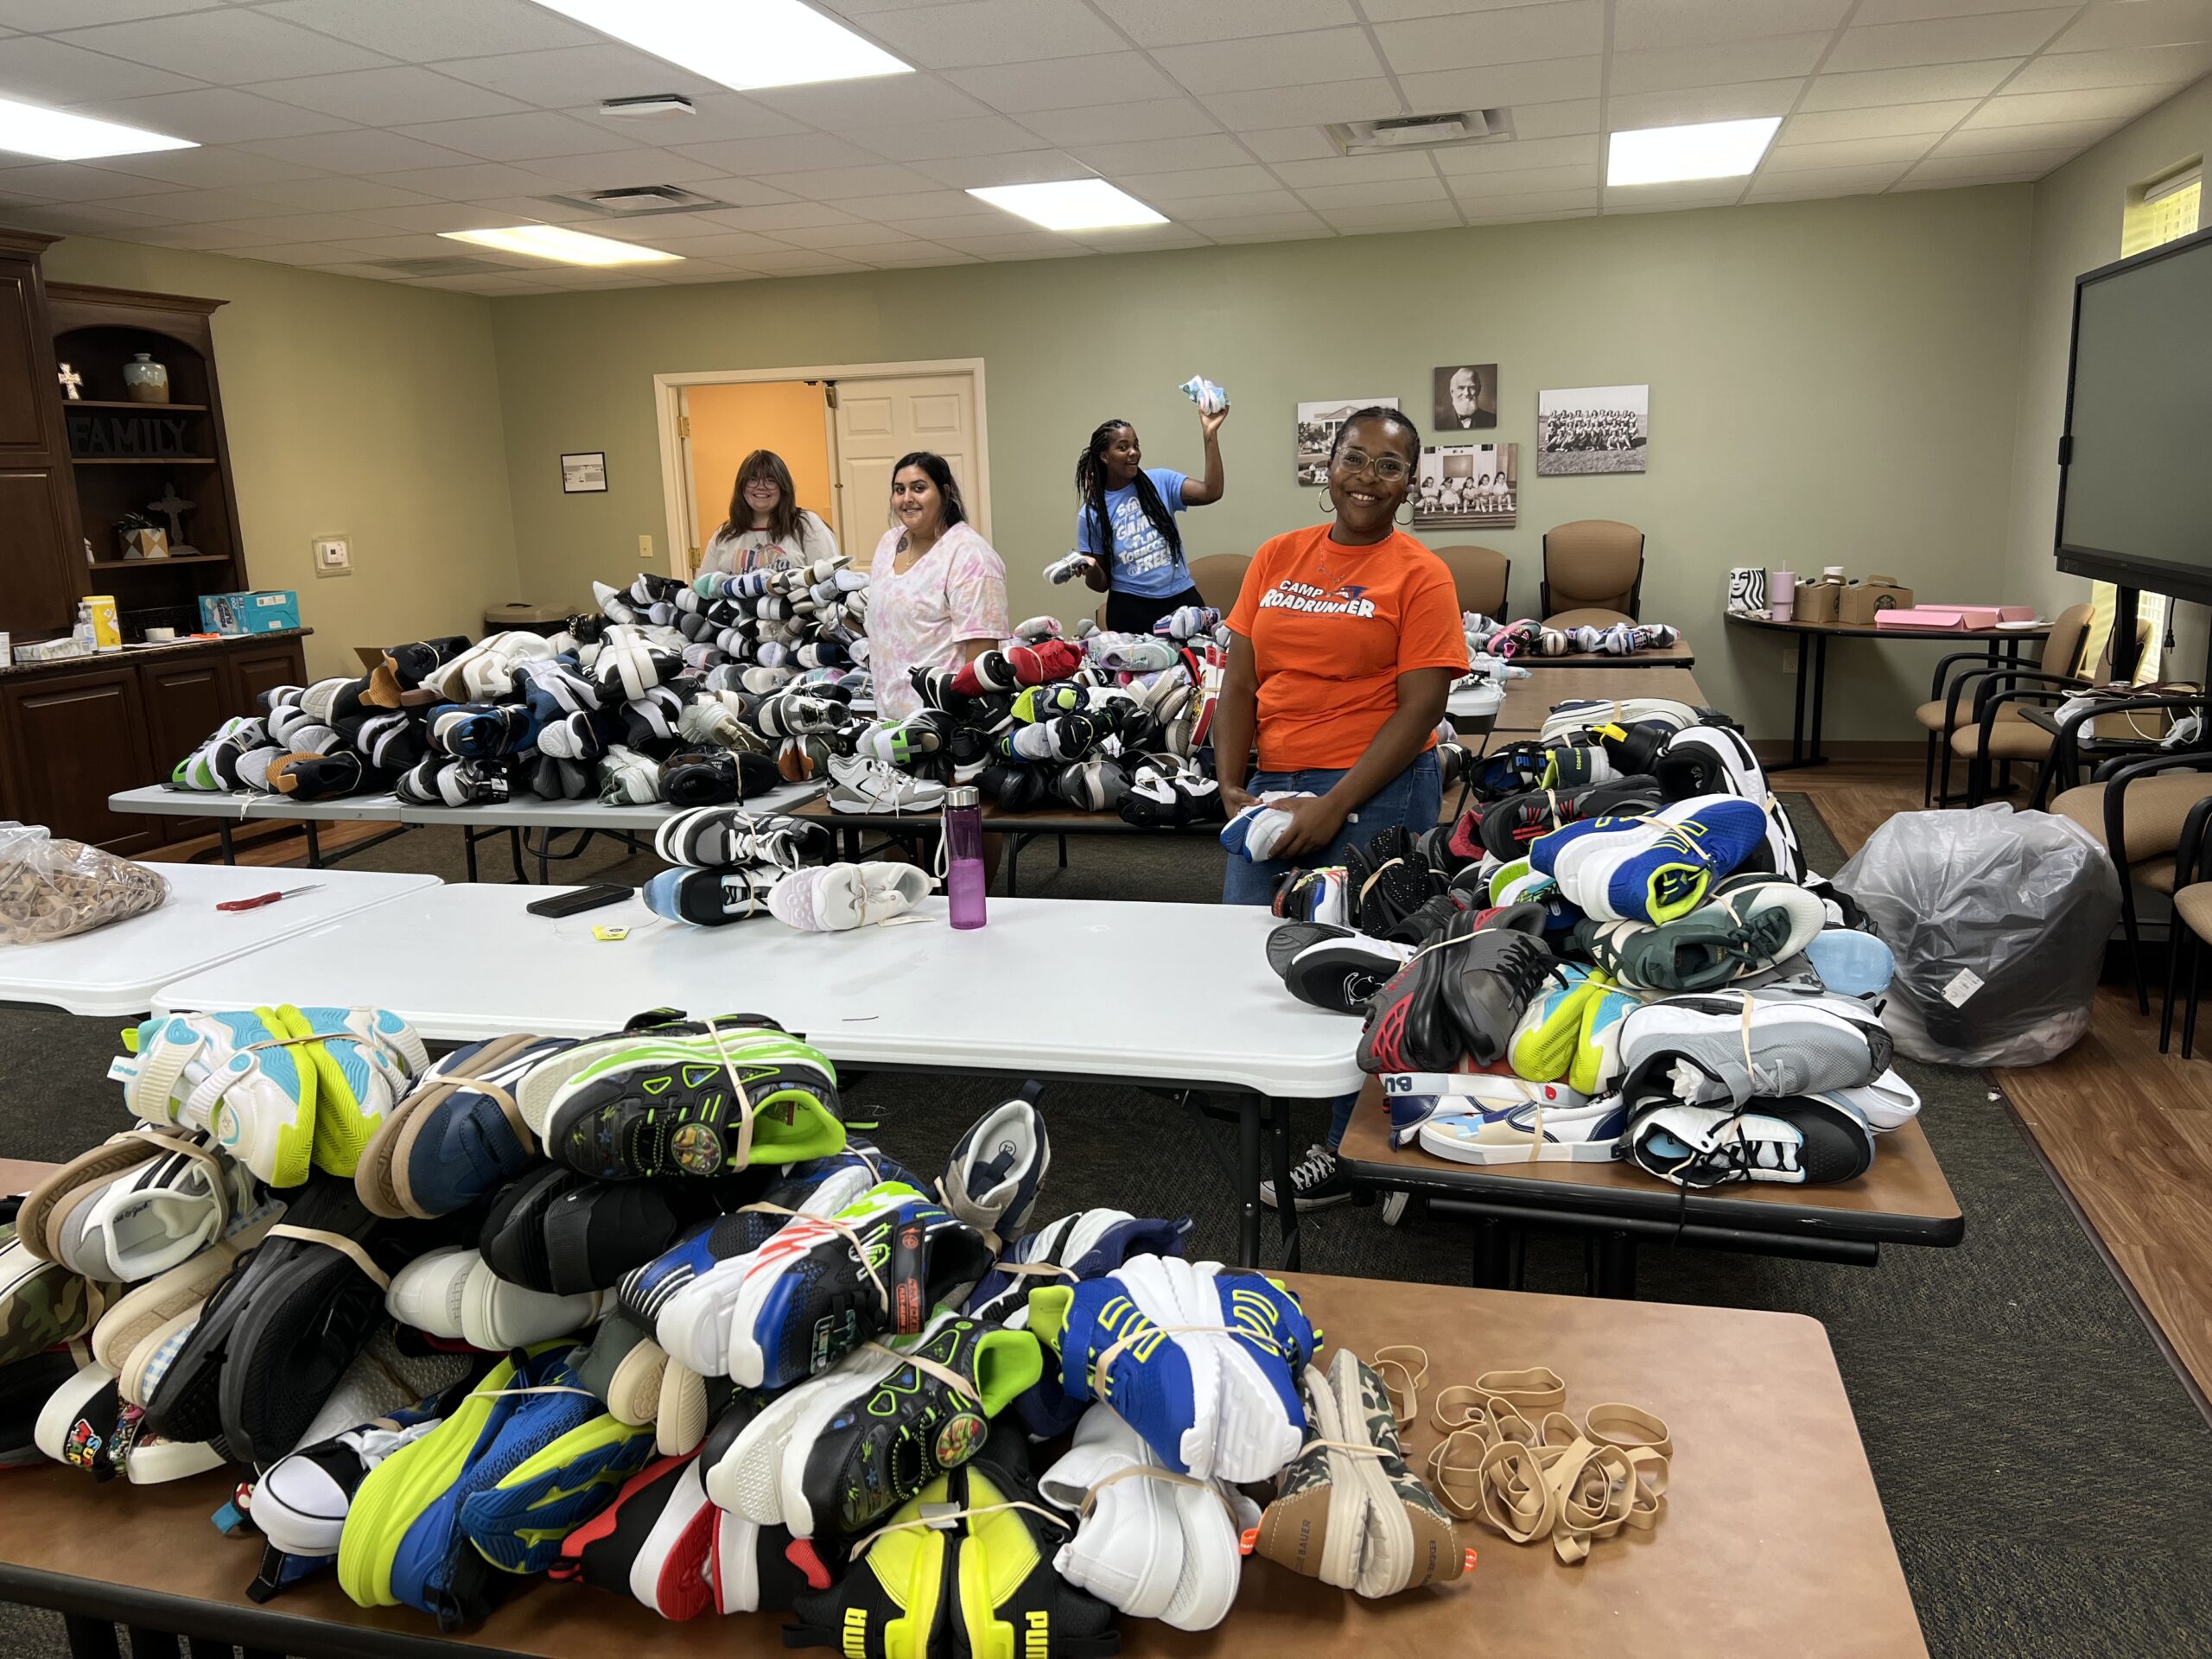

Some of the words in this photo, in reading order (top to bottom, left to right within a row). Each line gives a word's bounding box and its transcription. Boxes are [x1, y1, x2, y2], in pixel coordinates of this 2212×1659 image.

[68, 417, 188, 453] FAMILY
[1133, 529, 1158, 548] PLAY
[1279, 580, 1325, 599] CAMP
[1259, 588, 1376, 619] ROADRUNNER
[1516, 755, 1546, 768] PUA
[1298, 1519, 1312, 1555] BAUER
